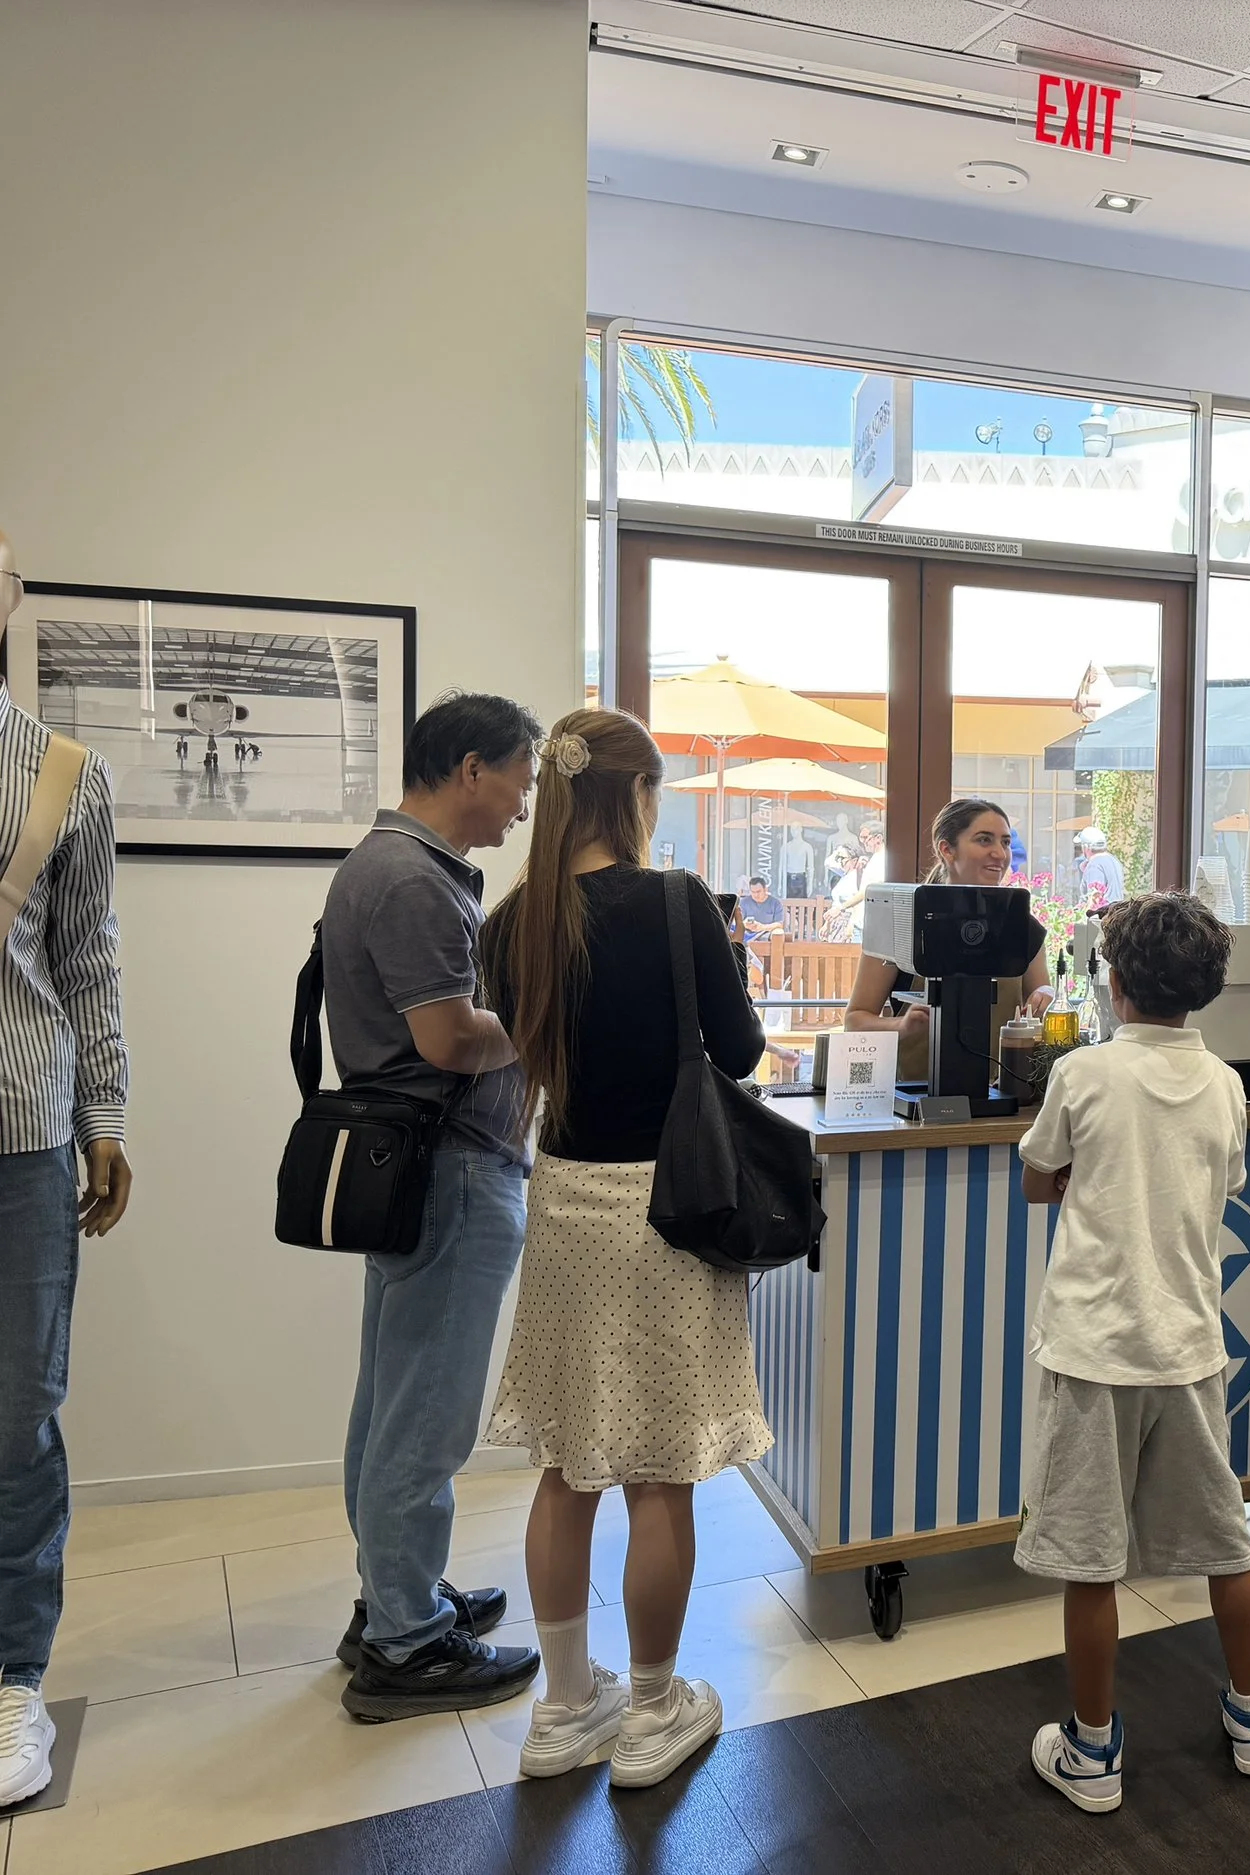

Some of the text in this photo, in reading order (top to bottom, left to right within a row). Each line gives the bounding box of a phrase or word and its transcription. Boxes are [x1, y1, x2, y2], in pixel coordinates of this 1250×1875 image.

[1035, 73, 1122, 155] EXIT
[821, 526, 1018, 554] THIS DOOR MUST REMAIN UNLOCKED DURING BUSINESS HOURS
[758, 797, 772, 835] KLEIN
